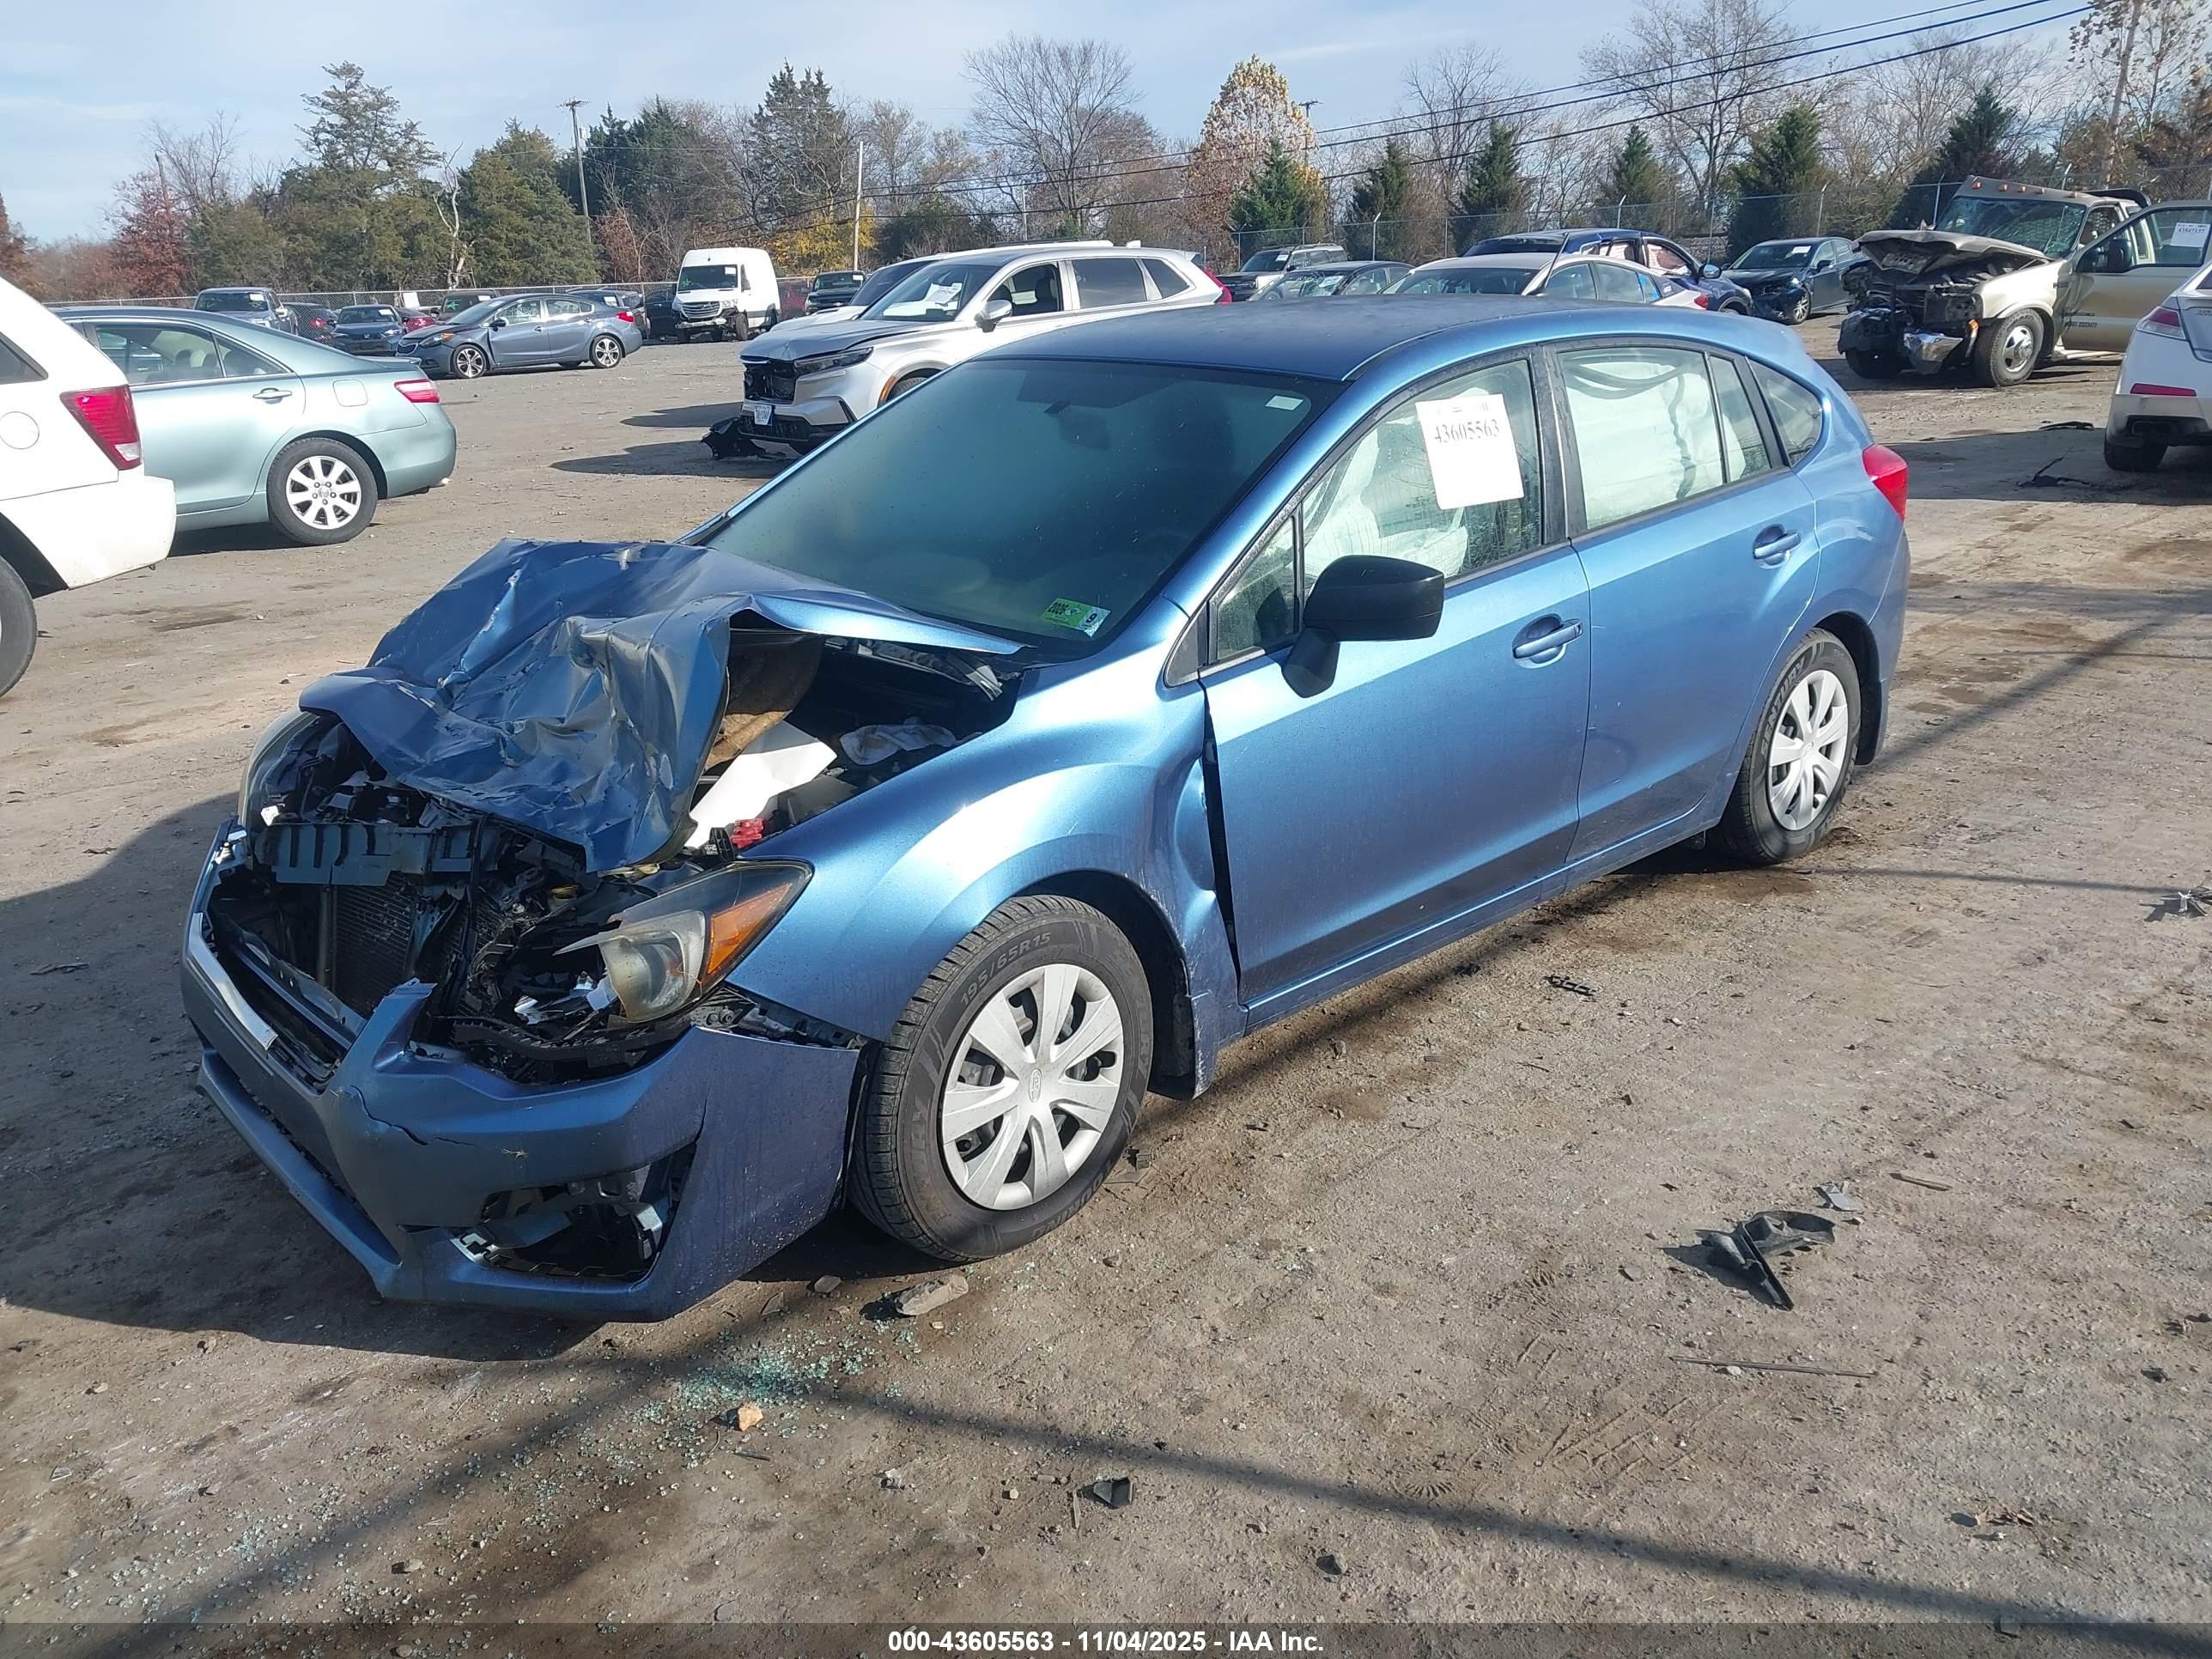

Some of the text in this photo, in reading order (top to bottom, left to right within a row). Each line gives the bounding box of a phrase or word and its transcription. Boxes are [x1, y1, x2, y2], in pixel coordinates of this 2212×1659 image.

[1434, 418, 1499, 443] 43605563
[1760, 655, 1805, 757] SENTURY
[960, 932, 1052, 1006] 195/65R15
